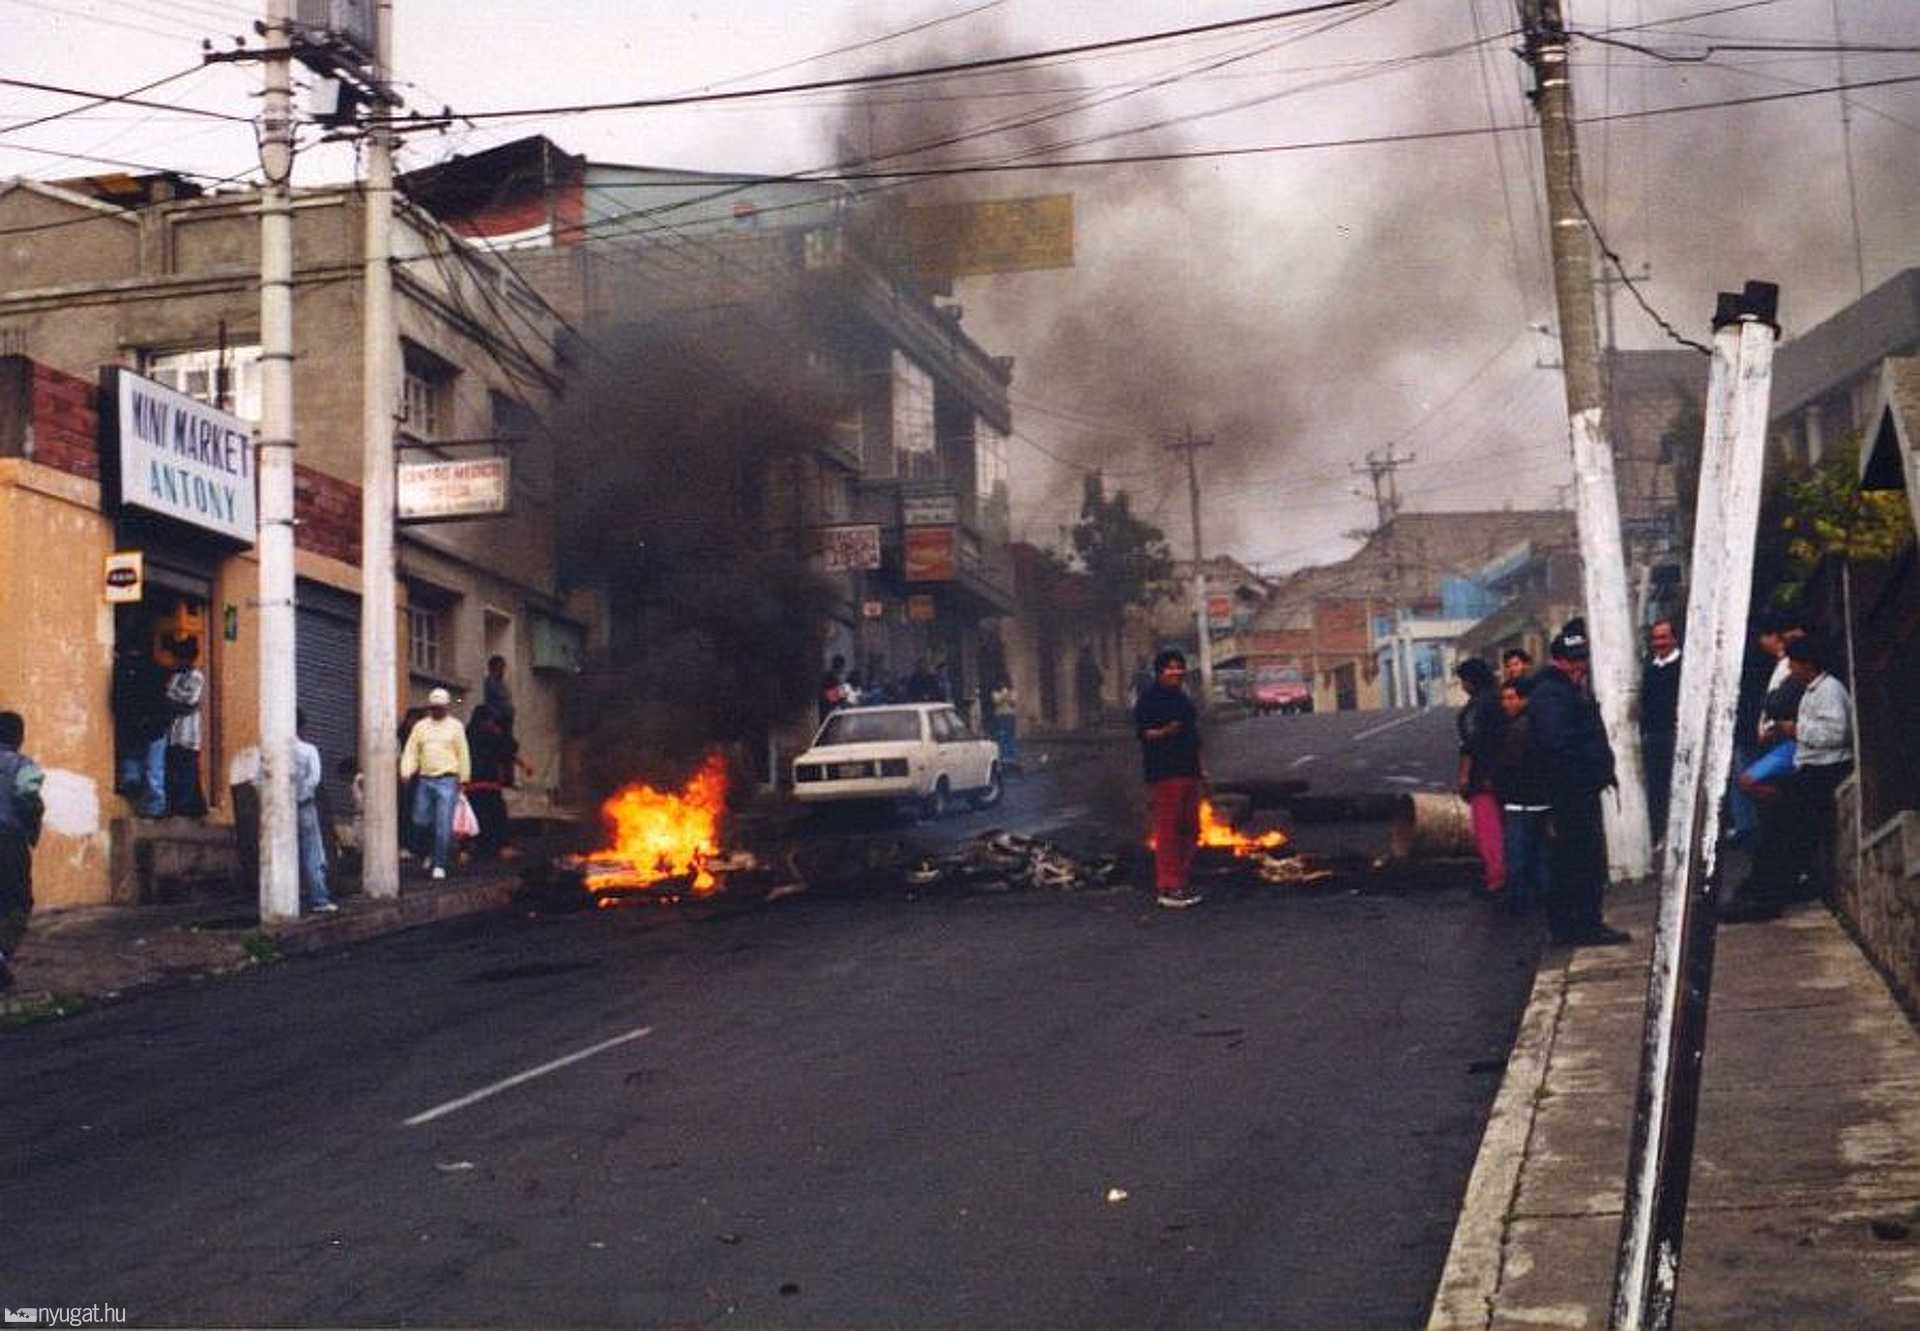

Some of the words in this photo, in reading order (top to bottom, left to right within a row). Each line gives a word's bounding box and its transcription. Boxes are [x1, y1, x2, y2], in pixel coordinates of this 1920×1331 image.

[132, 390, 168, 449] MINI
[174, 408, 249, 478] MARKET
[150, 460, 235, 523] ANTONY
